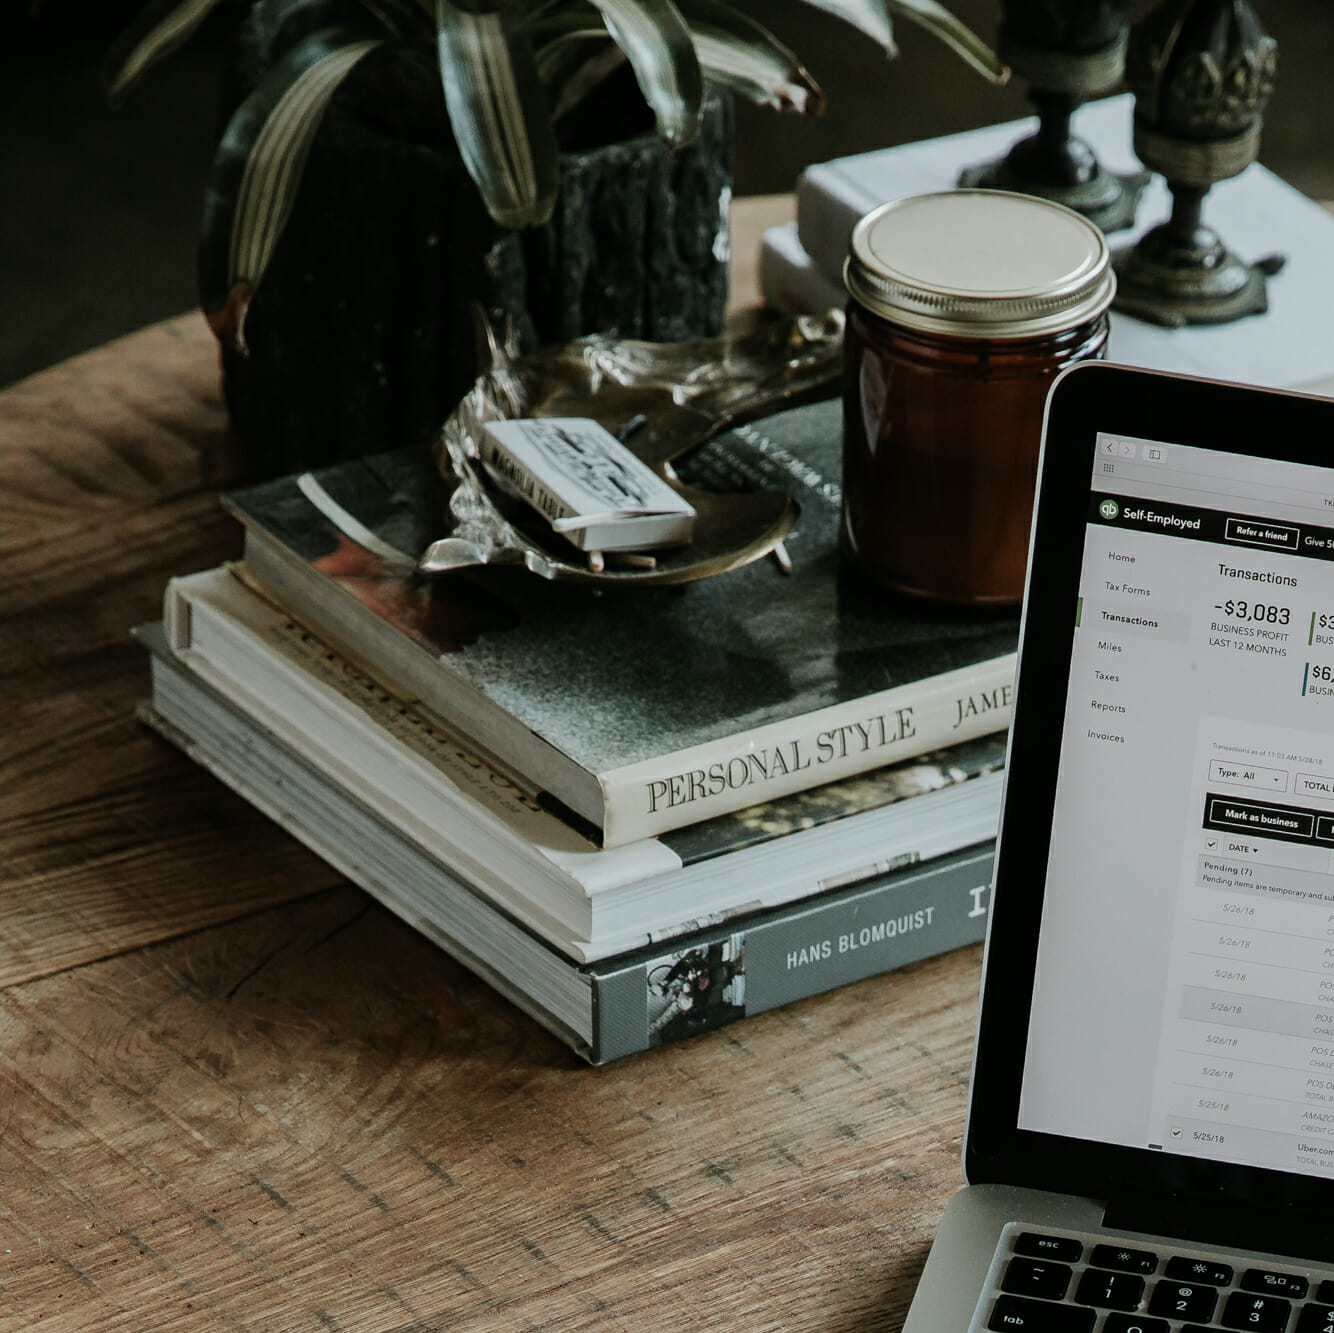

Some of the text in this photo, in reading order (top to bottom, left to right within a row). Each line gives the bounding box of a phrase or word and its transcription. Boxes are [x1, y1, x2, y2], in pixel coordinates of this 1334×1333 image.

[1100, 502, 1117, 517] qb
[1122, 506, 1201, 530] Self-Employed
[1235, 524, 1289, 542] Refer a friend
[1303, 535, 1326, 548] Give
[1107, 550, 1136, 564] Home
[1217, 562, 1298, 588] Transactions
[1104, 580, 1151, 597] Tax Forms
[1100, 610, 1159, 628] Transactions
[1209, 621, 1289, 642] BUSINESS PROFIT
[1097, 640, 1122, 653] Miles
[1208, 636, 1288, 658] LAST 12 MONTHS
[1093, 669, 1120, 683] Taxes
[1090, 699, 1127, 714] Reports
[1086, 728, 1125, 744] Invoices
[647, 740, 811, 814] PERSONAL
[816, 707, 916, 764] STYLE
[1217, 766, 1256, 780] Type: All
[1302, 779, 1331, 793] TOTAL
[1224, 807, 1299, 829] Mark as business
[1227, 842, 1250, 854] DATE
[1203, 860, 1254, 878] Pending (7)
[787, 907, 935, 970] HANS BLOMQUIST
[1192, 1130, 1225, 1144] 5/25/18
[1037, 1239, 1059, 1250] esc
[1002, 1314, 1025, 1326] tab
